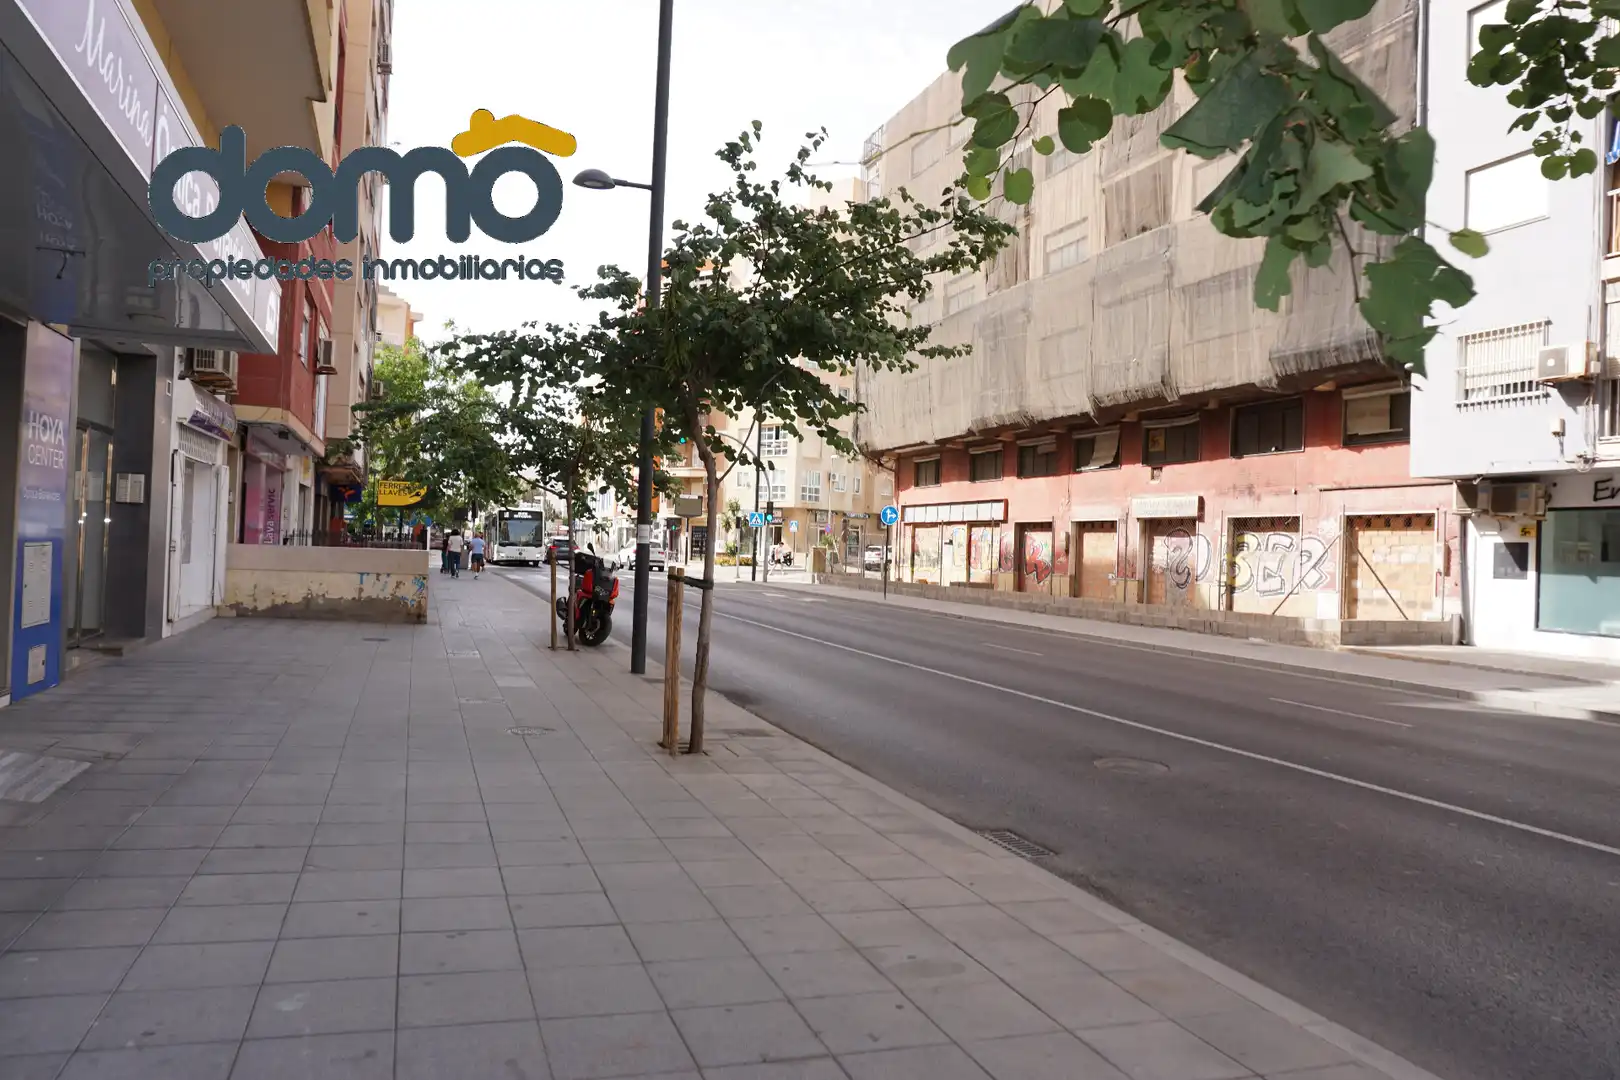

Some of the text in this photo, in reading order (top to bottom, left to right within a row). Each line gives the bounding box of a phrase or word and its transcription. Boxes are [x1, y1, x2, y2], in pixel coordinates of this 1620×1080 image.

[75, 0, 152, 147] Marina
[28, 410, 65, 446] HOYA
[28, 443, 64, 469] CENTER
